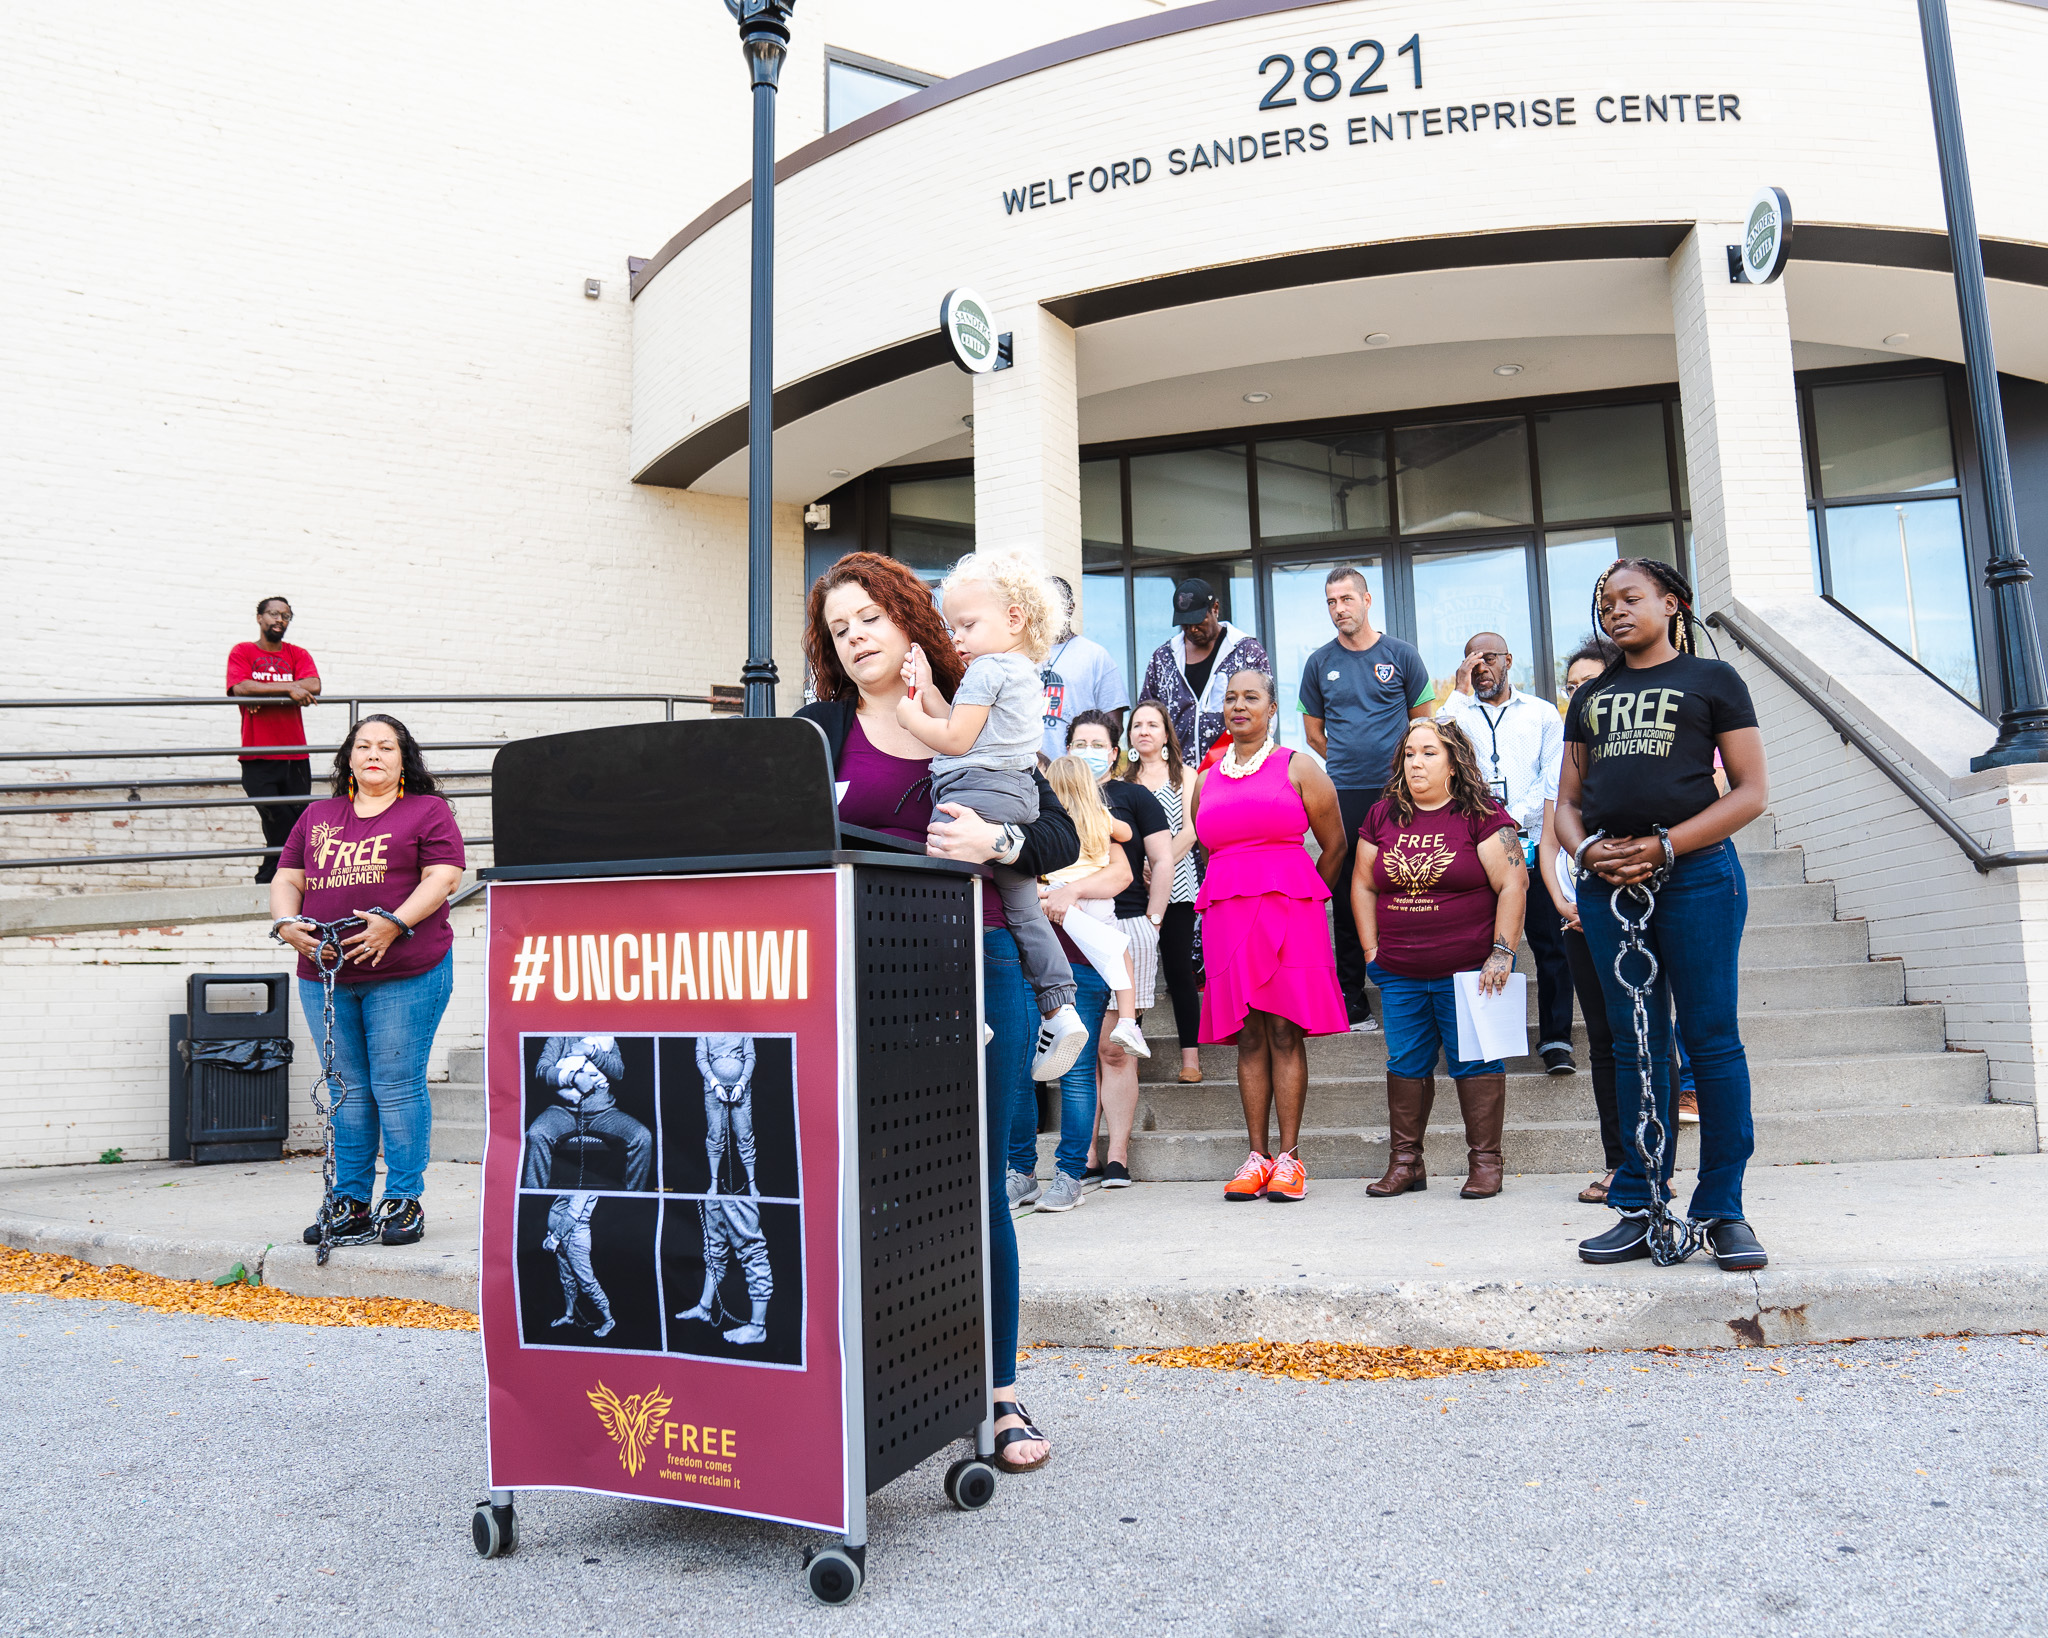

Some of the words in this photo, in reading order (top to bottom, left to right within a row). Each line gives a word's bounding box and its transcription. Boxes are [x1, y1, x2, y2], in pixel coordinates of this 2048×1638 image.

[1258, 33, 1424, 111] 2821
[1003, 157, 1152, 215] WELFORD
[1168, 123, 1329, 175] SANDERS
[1347, 97, 1576, 145] ENTERPRISE
[1596, 94, 1742, 124] CENTER
[1746, 212, 1776, 250] SANDERS
[954, 311, 991, 341] SANDERS
[961, 332, 986, 356] CENTER
[1433, 595, 1511, 617] SANDERS
[1590, 688, 1684, 736] FREE
[1608, 732, 1621, 742] (IT'S
[1621, 730, 1633, 740] NOT
[1633, 729, 1642, 738] AN
[1643, 729, 1675, 741] ACRONYM)
[1603, 739, 1673, 758] MOVEMENT
[318, 833, 392, 869] FREE
[1396, 833, 1445, 849] FREE
[306, 877, 318, 890] T'S
[318, 877, 324, 889] A
[326, 871, 385, 888] MOVEMENT
[342, 866, 352, 874] NOT
[509, 929, 809, 1002] #UNCHAINWI
[664, 1422, 737, 1458] FREE
[667, 1453, 702, 1469] freedom
[705, 1460, 732, 1473] comes
[659, 1467, 682, 1481] when
[684, 1472, 697, 1483] we
[699, 1474, 731, 1488] reclaim
[733, 1477, 741, 1490] it
